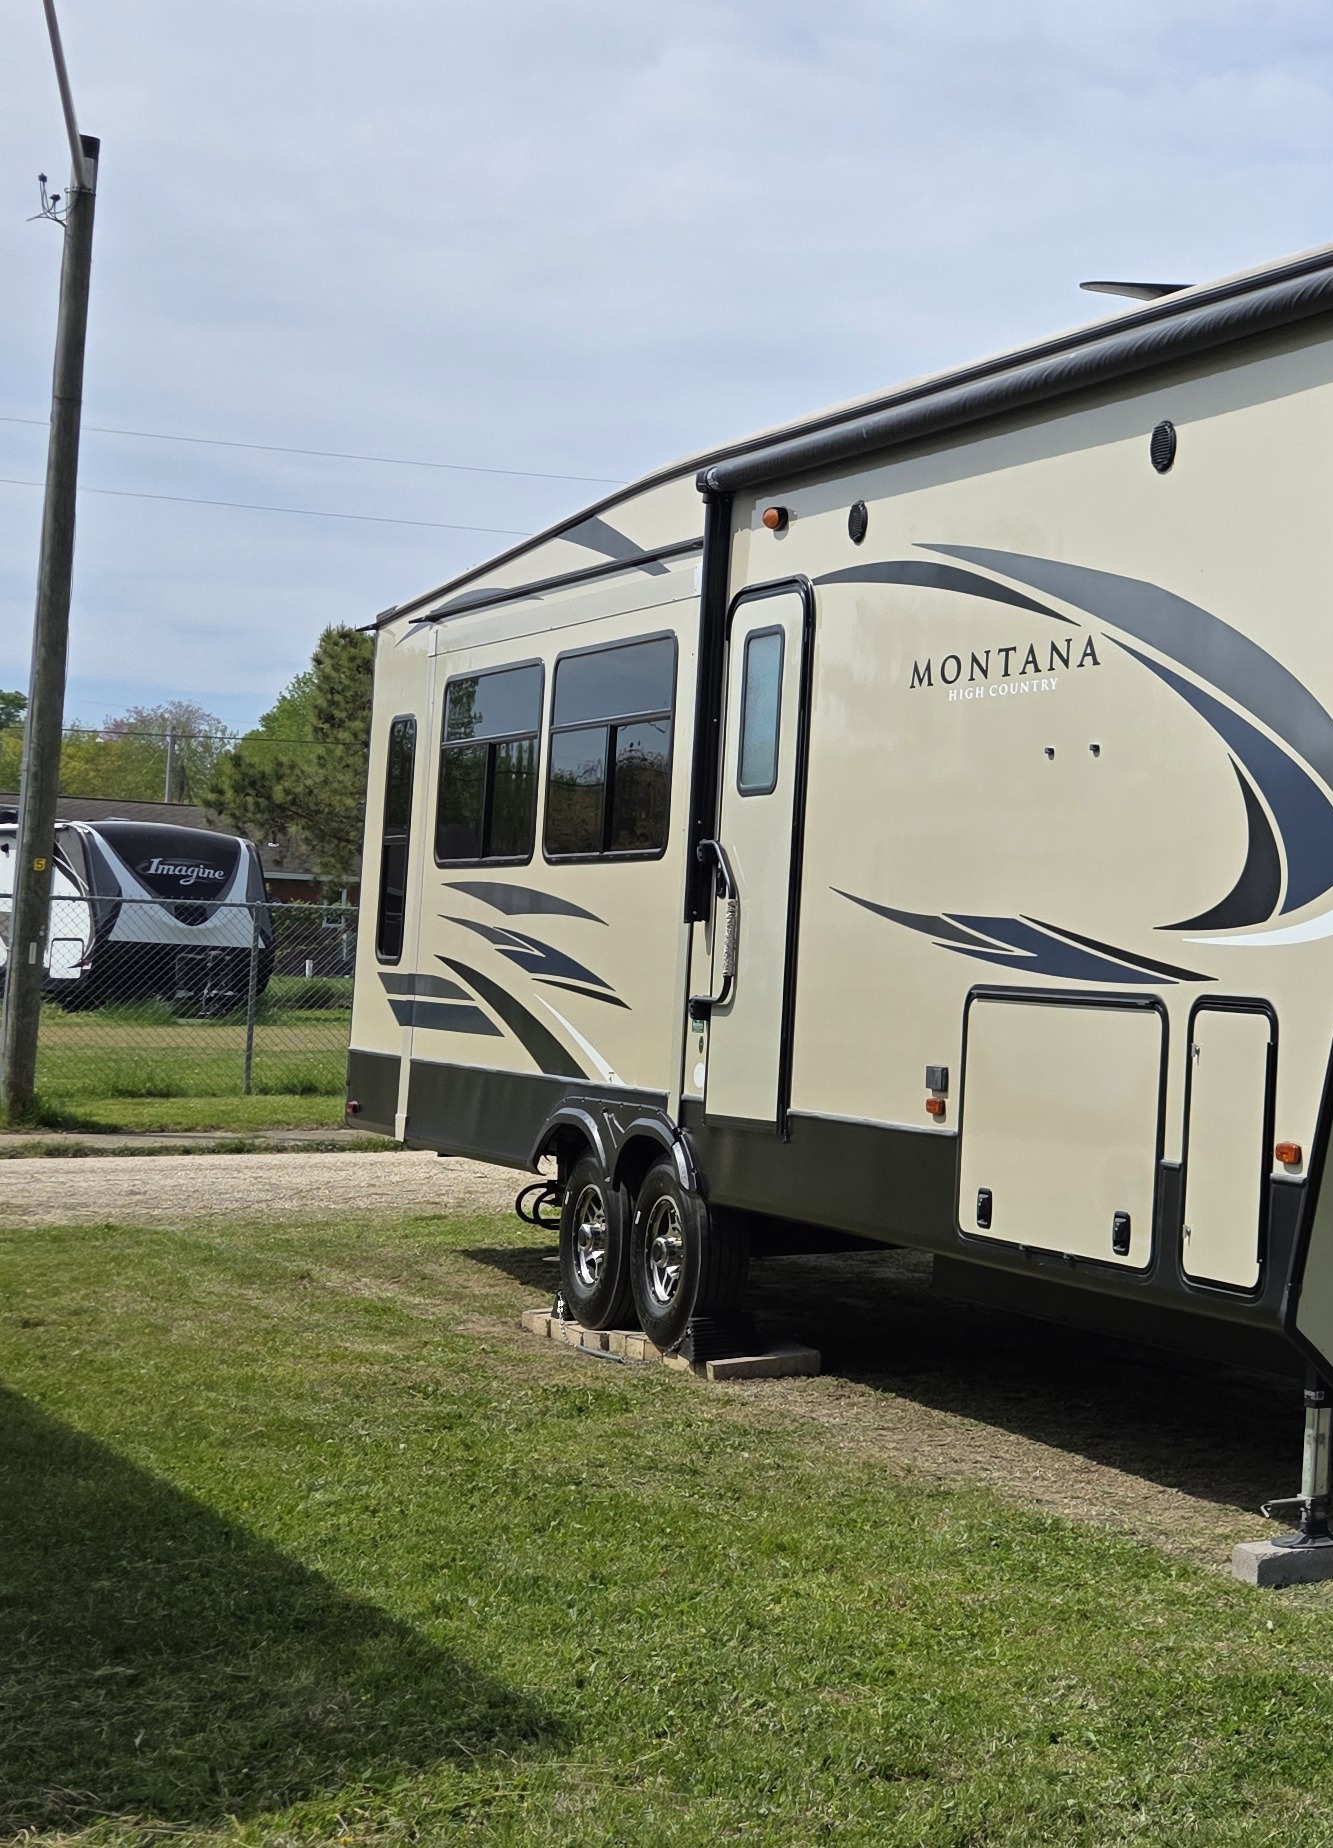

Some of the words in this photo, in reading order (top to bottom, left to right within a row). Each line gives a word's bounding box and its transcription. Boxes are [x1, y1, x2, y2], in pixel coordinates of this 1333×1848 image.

[909, 635, 1101, 689] MONTANA
[949, 686, 985, 701] HIGH
[988, 677, 1059, 698] COUNTRY
[36, 860, 44, 870] 5
[146, 857, 227, 886] Imagine
